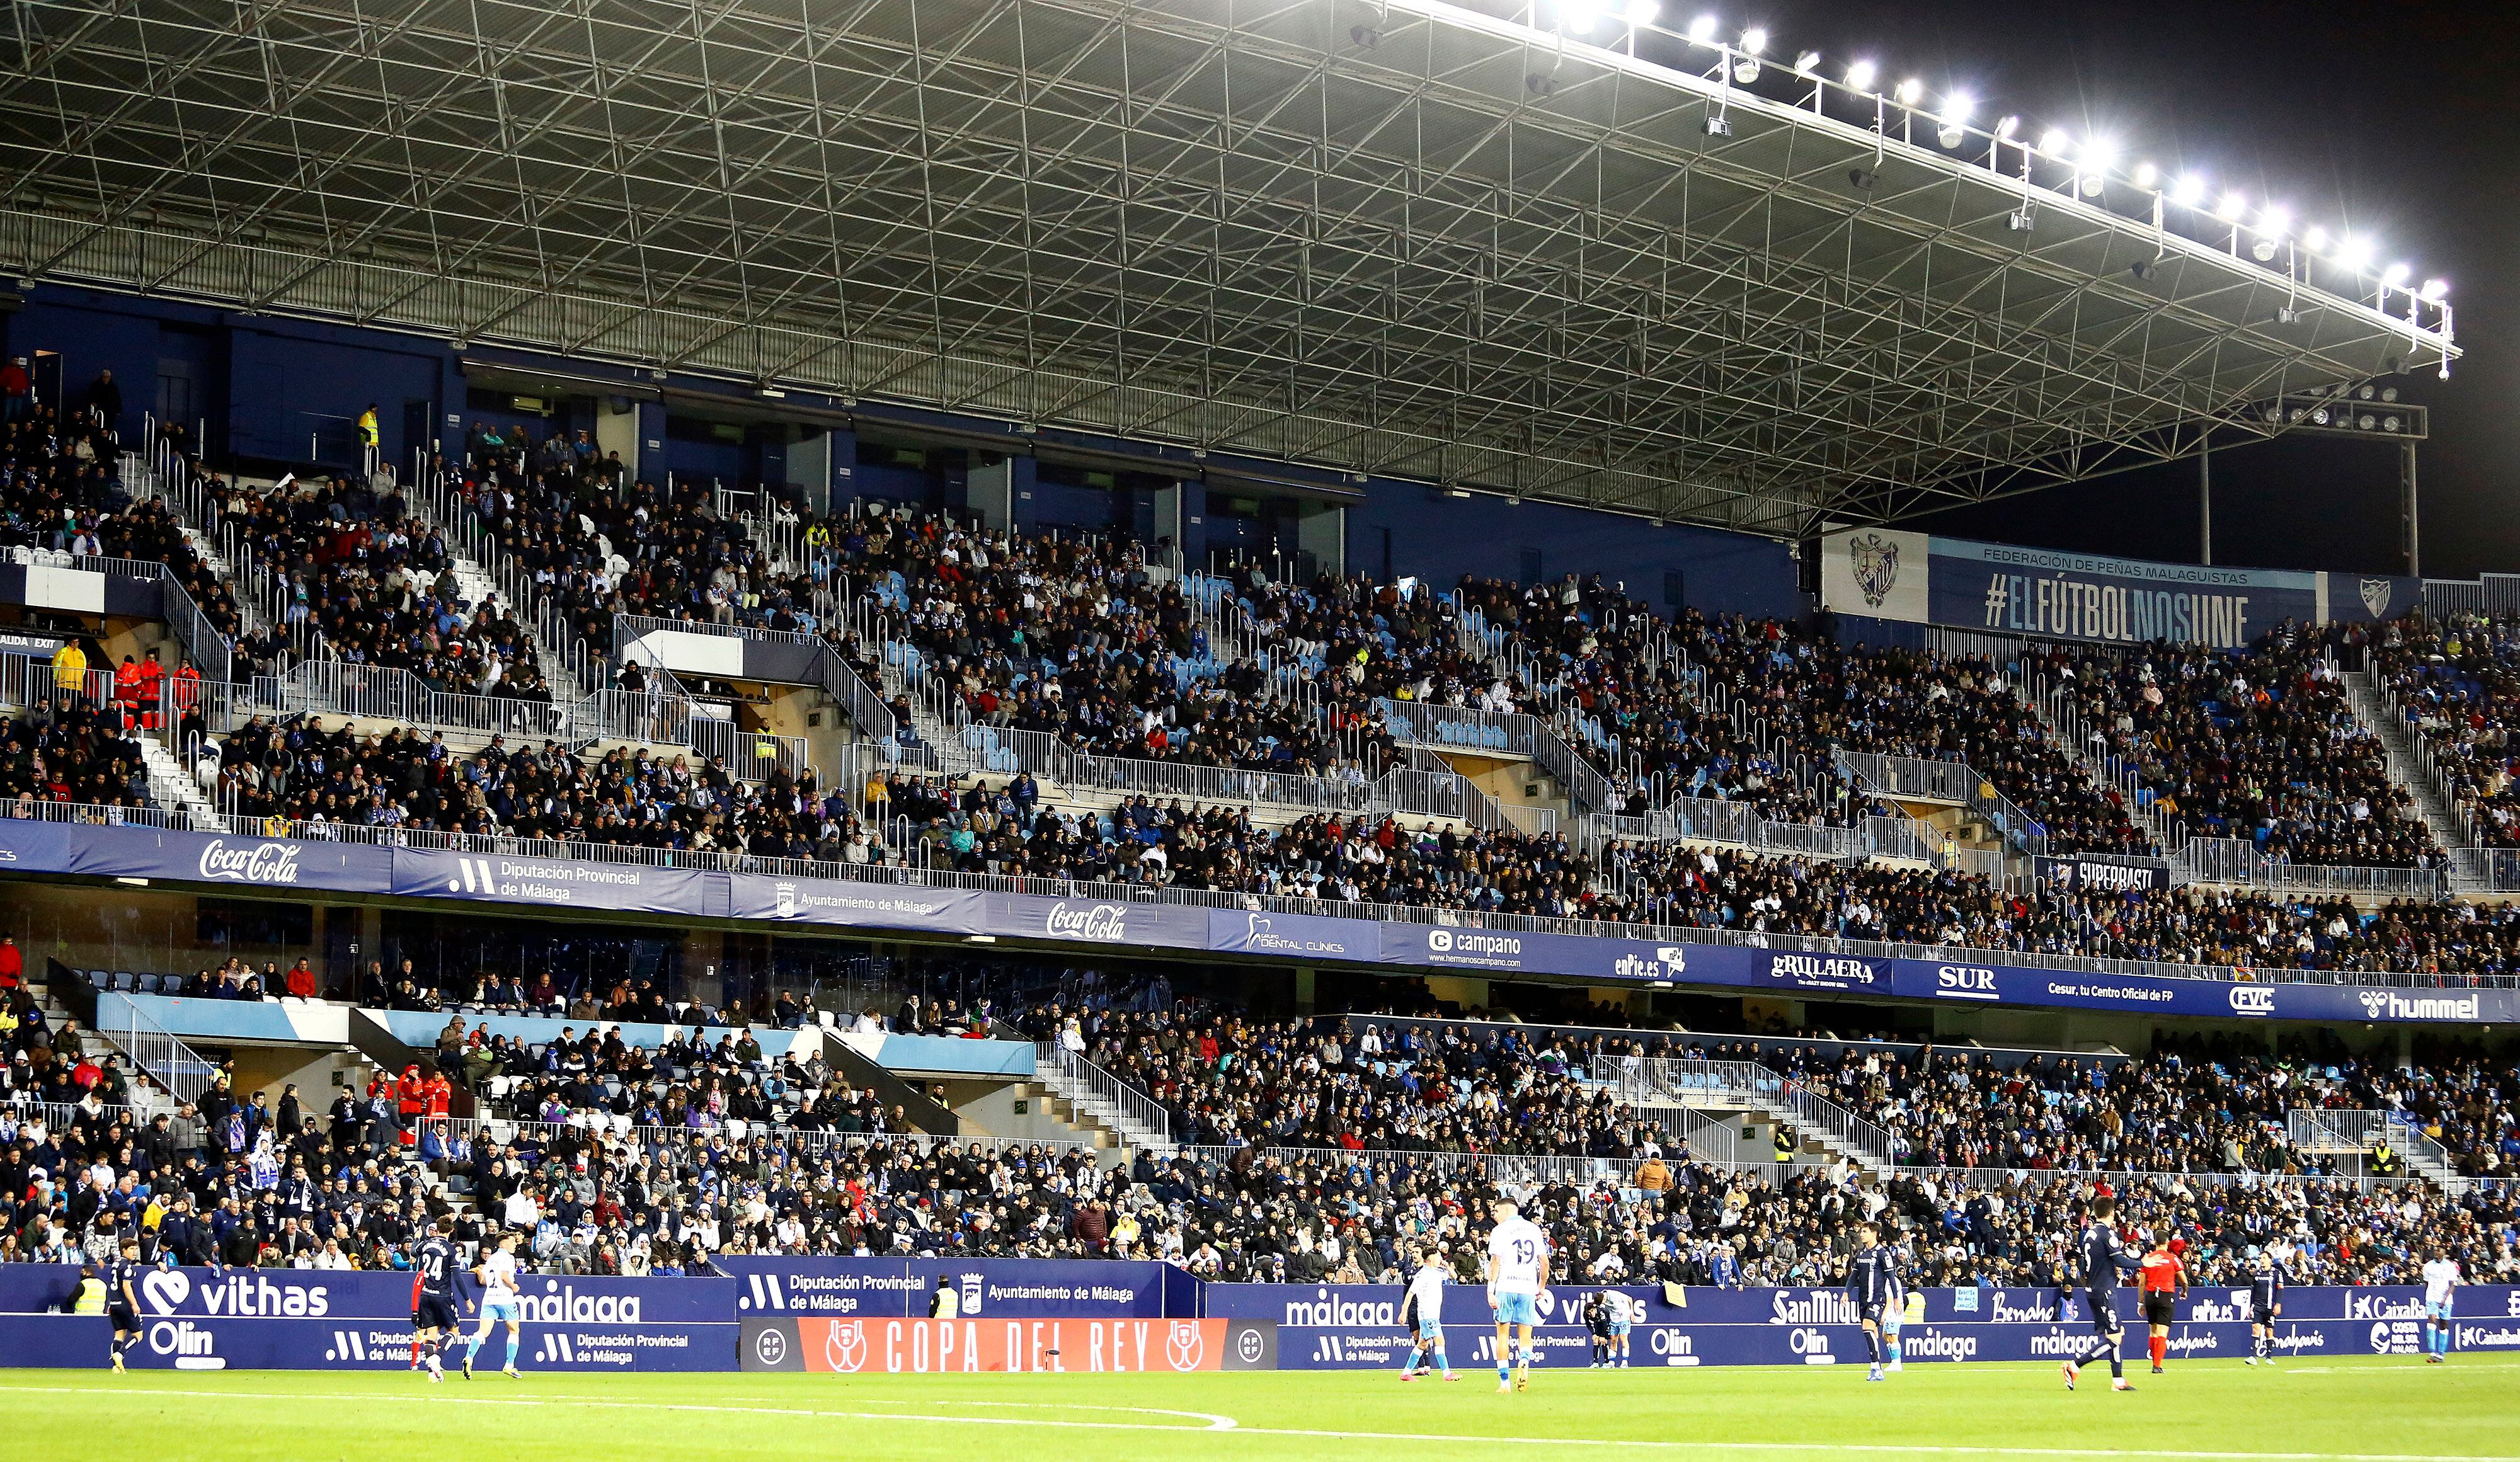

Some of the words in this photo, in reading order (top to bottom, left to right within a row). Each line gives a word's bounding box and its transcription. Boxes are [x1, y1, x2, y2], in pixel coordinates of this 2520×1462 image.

[1984, 549, 2071, 568] FEDERACIÓN
[2075, 559, 2093, 571] DE
[2097, 560, 2142, 576] PEÑAS
[2146, 568, 2248, 585] MALAGUISTAS
[34, 638, 56, 649] EXIT
[200, 839, 302, 883] Coca-Cola
[501, 860, 575, 882] Diputación
[576, 865, 640, 886] Provincial
[501, 882, 518, 898] de
[522, 882, 570, 901] Málaga
[801, 893, 876, 910] Ayuntamiento
[879, 898, 891, 911] de
[894, 899, 932, 915] Málaga
[1046, 901, 1128, 940] Coca-Cola
[1261, 939, 1303, 950] DENTAL
[1457, 934, 1521, 956] campano
[1429, 954, 1521, 968] www.hermanoscampano.com
[1939, 966, 1996, 990] SUR
[2048, 982, 2078, 997] Cesur,
[2080, 985, 2090, 997] tu
[2091, 985, 2120, 999] Centro
[2121, 986, 2148, 1000] Oficial
[2150, 988, 2161, 1001] de
[2162, 990, 2174, 1002] FP
[2389, 991, 2478, 1019] hummel
[1512, 1239, 1535, 1265] 19
[422, 1254, 443, 1281] 24
[789, 1273, 861, 1294] Diputación
[862, 1273, 925, 1291] Provincial
[988, 1282, 1069, 1300] Ayuntamiento
[1074, 1286, 1089, 1300] de
[1091, 1285, 1134, 1302] Málaga
[200, 1275, 328, 1316] vithas
[789, 1295, 807, 1310] de
[810, 1295, 857, 1313] Málaga
[1286, 1288, 1394, 1325] málaga
[2373, 1296, 2426, 1319] CaixaBa
[149, 1321, 213, 1355] Olin
[369, 1331, 420, 1345] Diputaci
[2391, 1322, 2420, 1334] COSTA
[577, 1334, 634, 1349] Diputación
[636, 1334, 688, 1347] Provincial
[886, 1320, 979, 1373] COPA
[1007, 1320, 1065, 1373] DEL
[1091, 1320, 1148, 1372] REY
[1346, 1335, 1392, 1349] Diputación
[1547, 1335, 1586, 1347] Provincial
[1651, 1327, 1692, 1356] Olin
[1790, 1328, 1828, 1354] Olin
[1905, 1327, 1976, 1362] málaga
[369, 1349, 385, 1361] de
[577, 1351, 590, 1362] de
[592, 1350, 633, 1365] Málaga
[1346, 1350, 1357, 1361] de
[1358, 1349, 1389, 1363] Málaga
